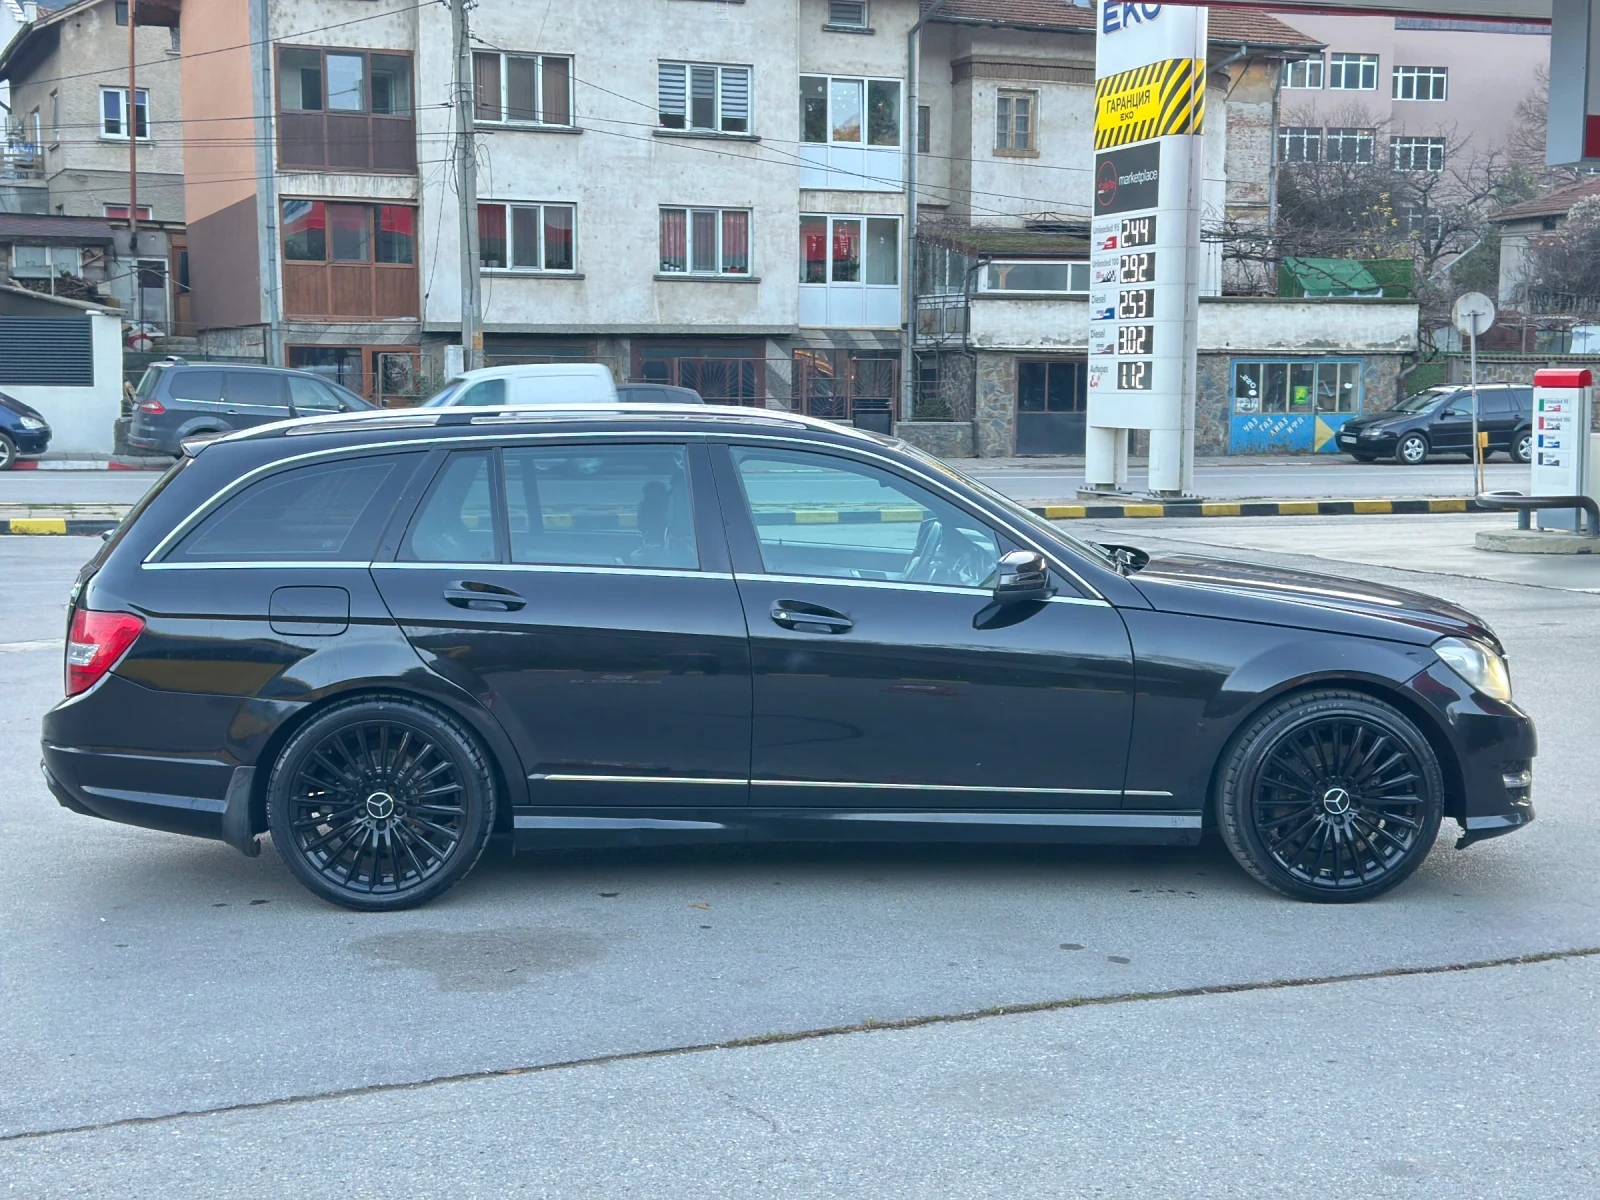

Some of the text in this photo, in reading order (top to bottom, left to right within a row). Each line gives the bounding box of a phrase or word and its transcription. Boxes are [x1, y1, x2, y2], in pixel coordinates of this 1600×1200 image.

[1106, 89, 1151, 114] ГАРАНЦИЯ
[1118, 169, 1158, 186] marketplace
[1093, 224, 1113, 234] Unleaded
[1121, 218, 1149, 247] 2.44
[1120, 253, 1148, 283] 2.92
[1091, 294, 1106, 304] Diesel
[1119, 290, 1146, 318] 2.53
[1090, 328, 1105, 338] Diesel
[1119, 326, 1146, 354] 3.02
